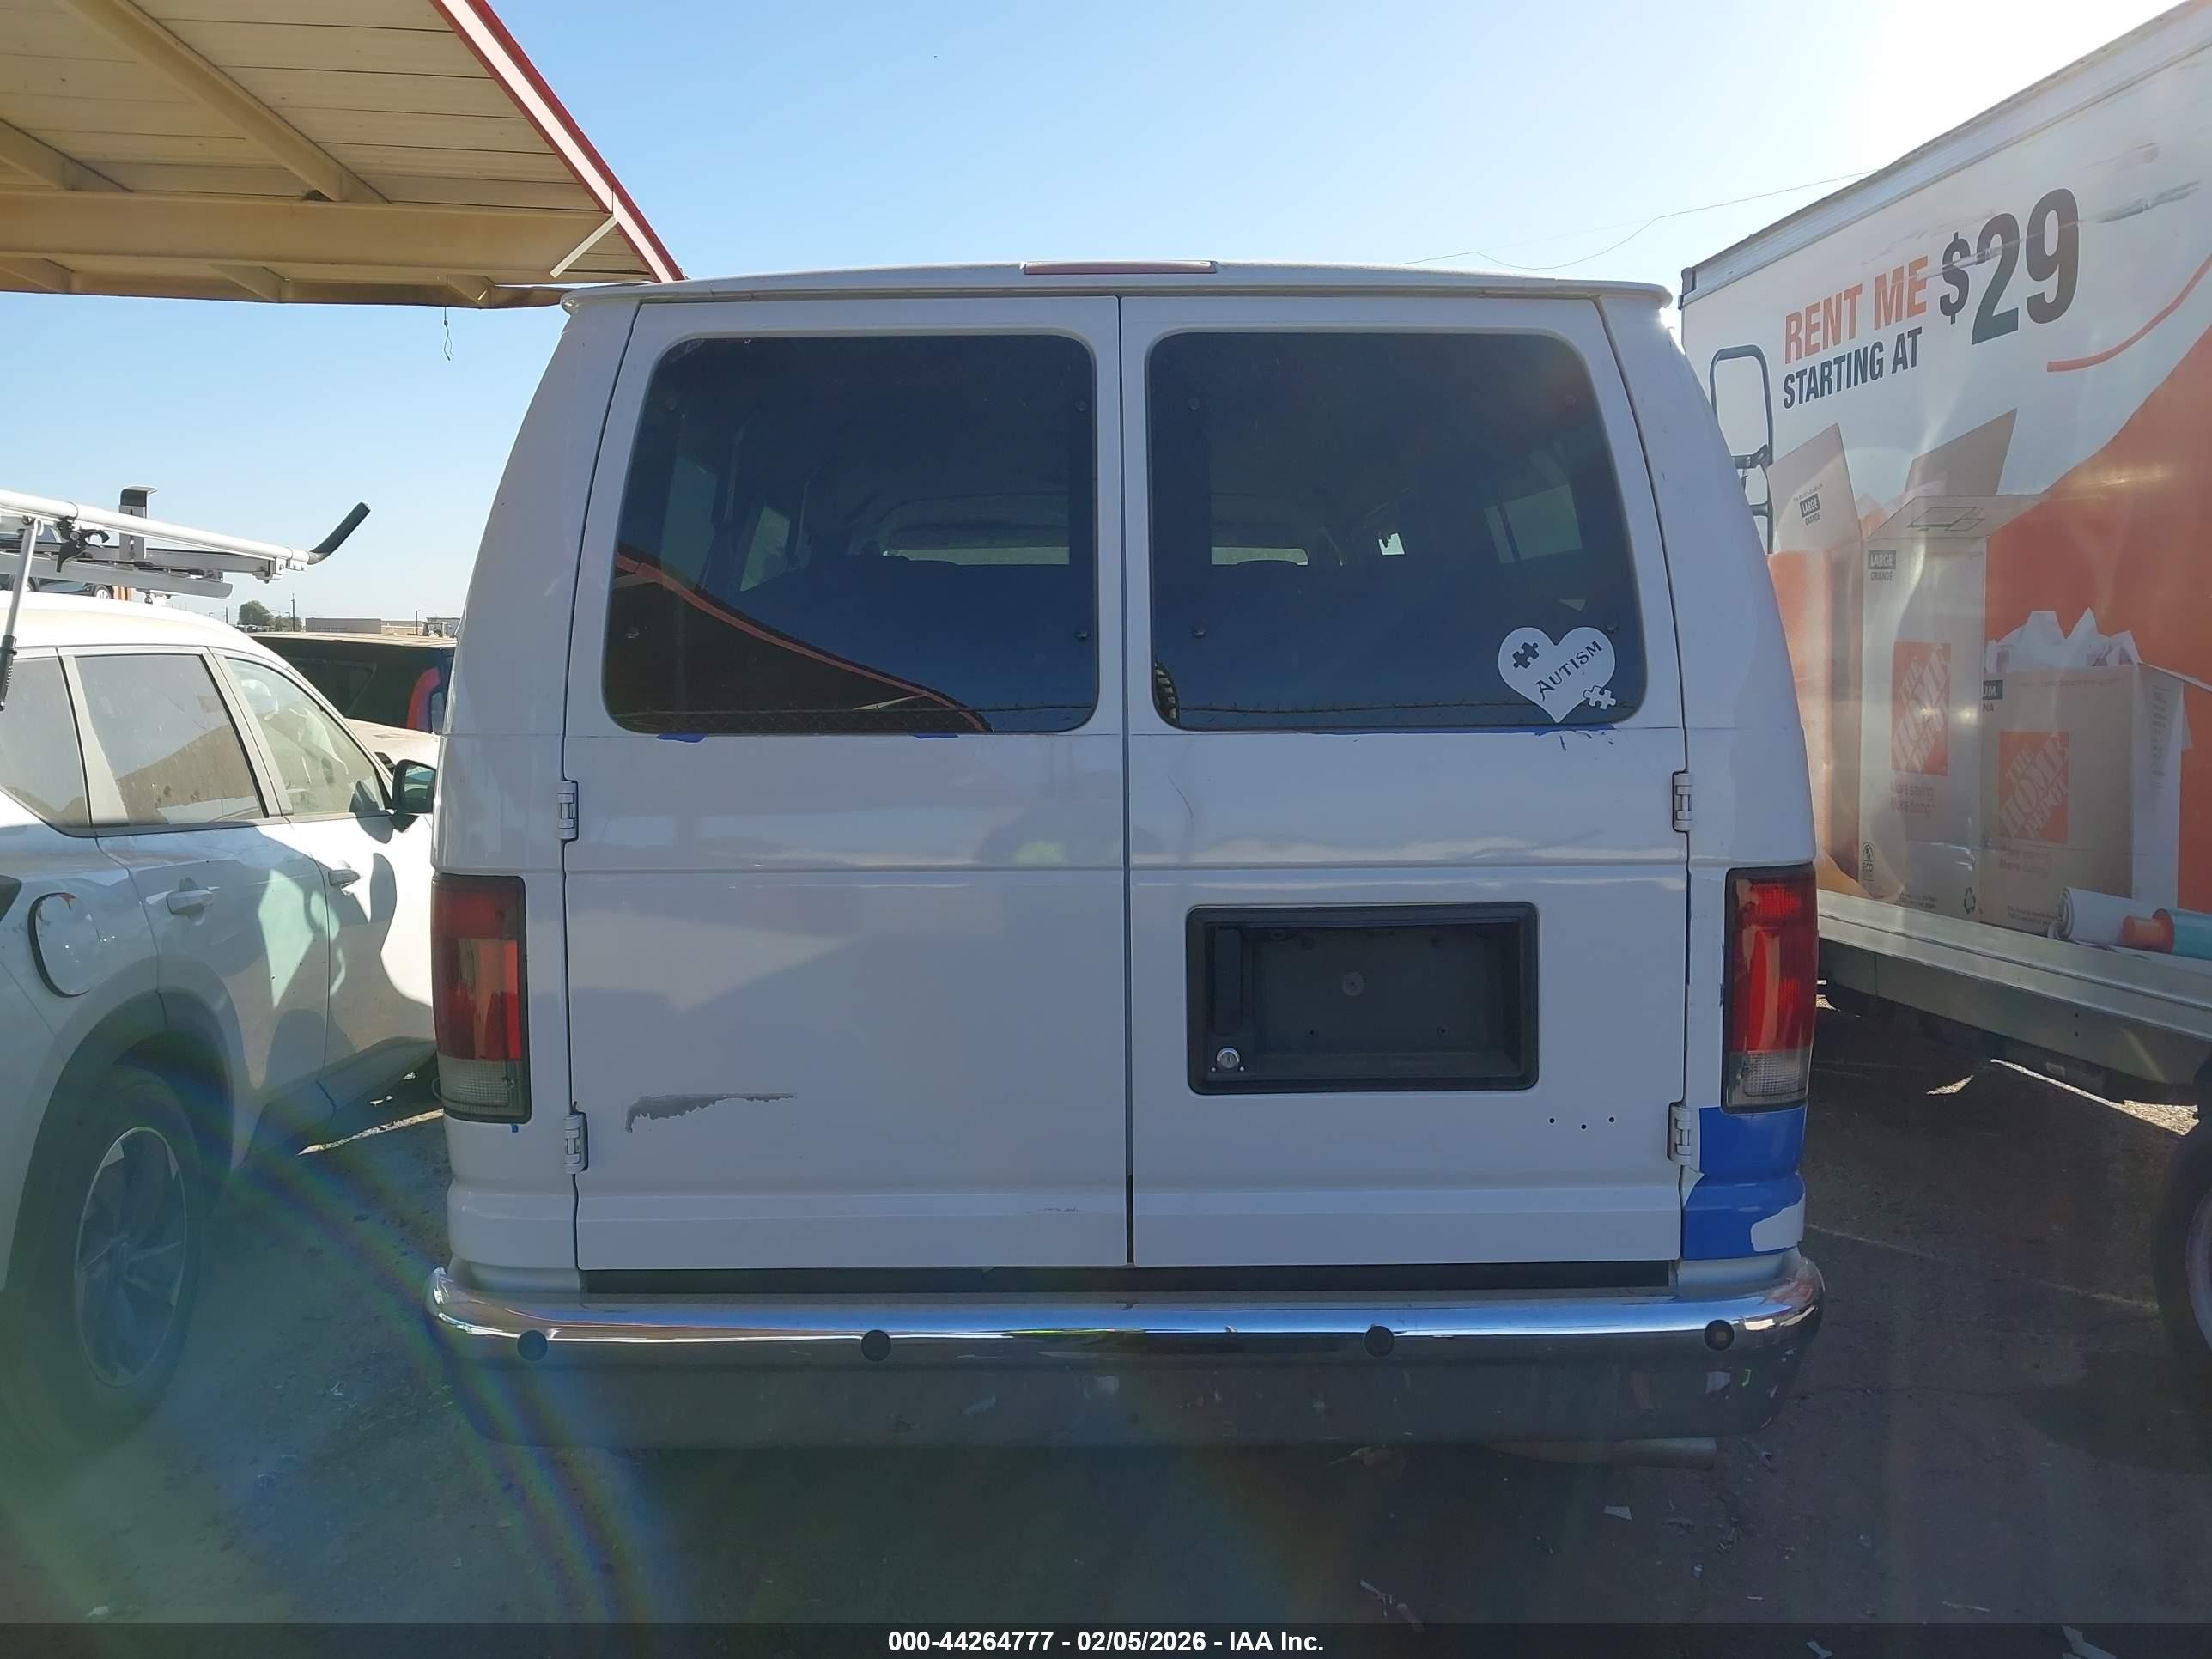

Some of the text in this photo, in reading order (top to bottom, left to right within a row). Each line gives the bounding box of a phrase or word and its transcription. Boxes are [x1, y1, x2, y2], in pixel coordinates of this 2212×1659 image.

[1784, 188, 2080, 364] RENT ME $29
[1783, 326, 1923, 409] STARTING AT
[1802, 496, 1819, 514] LARGE
[1870, 553, 1893, 565] LARGE
[1534, 640, 1603, 702] AUTISM
[1892, 644, 1950, 771] HOME
[2000, 732, 2068, 839] HOME
